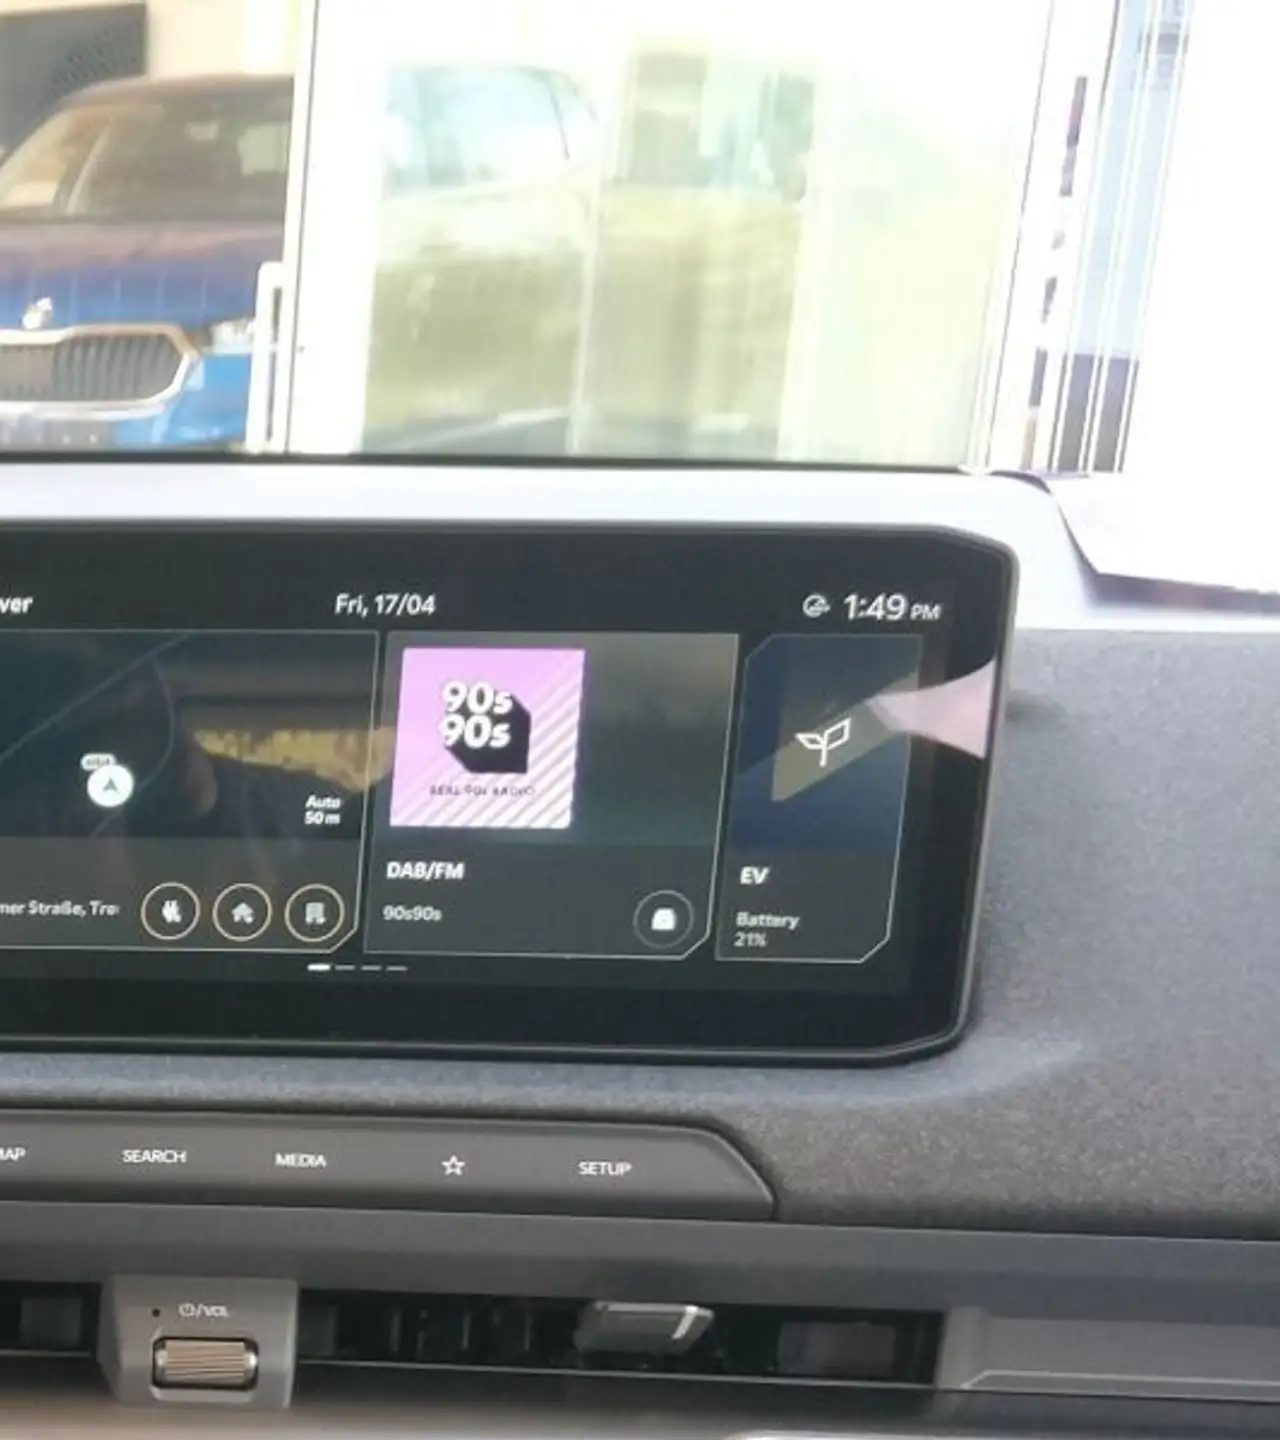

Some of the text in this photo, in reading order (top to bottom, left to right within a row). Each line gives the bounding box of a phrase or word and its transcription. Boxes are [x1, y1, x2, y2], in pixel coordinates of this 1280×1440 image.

[335, 592, 436, 619] Fri, 17/04
[843, 592, 941, 620] 1:49 PM
[443, 681, 513, 714] 90s
[438, 714, 511, 748] 90s
[386, 862, 465, 880] DAB/FM
[740, 866, 769, 885] EV
[736, 911, 800, 931] Battery
[122, 1149, 186, 1164] SEARCH
[275, 1153, 327, 1169] MEDIA
[578, 1161, 632, 1176] SETUP
